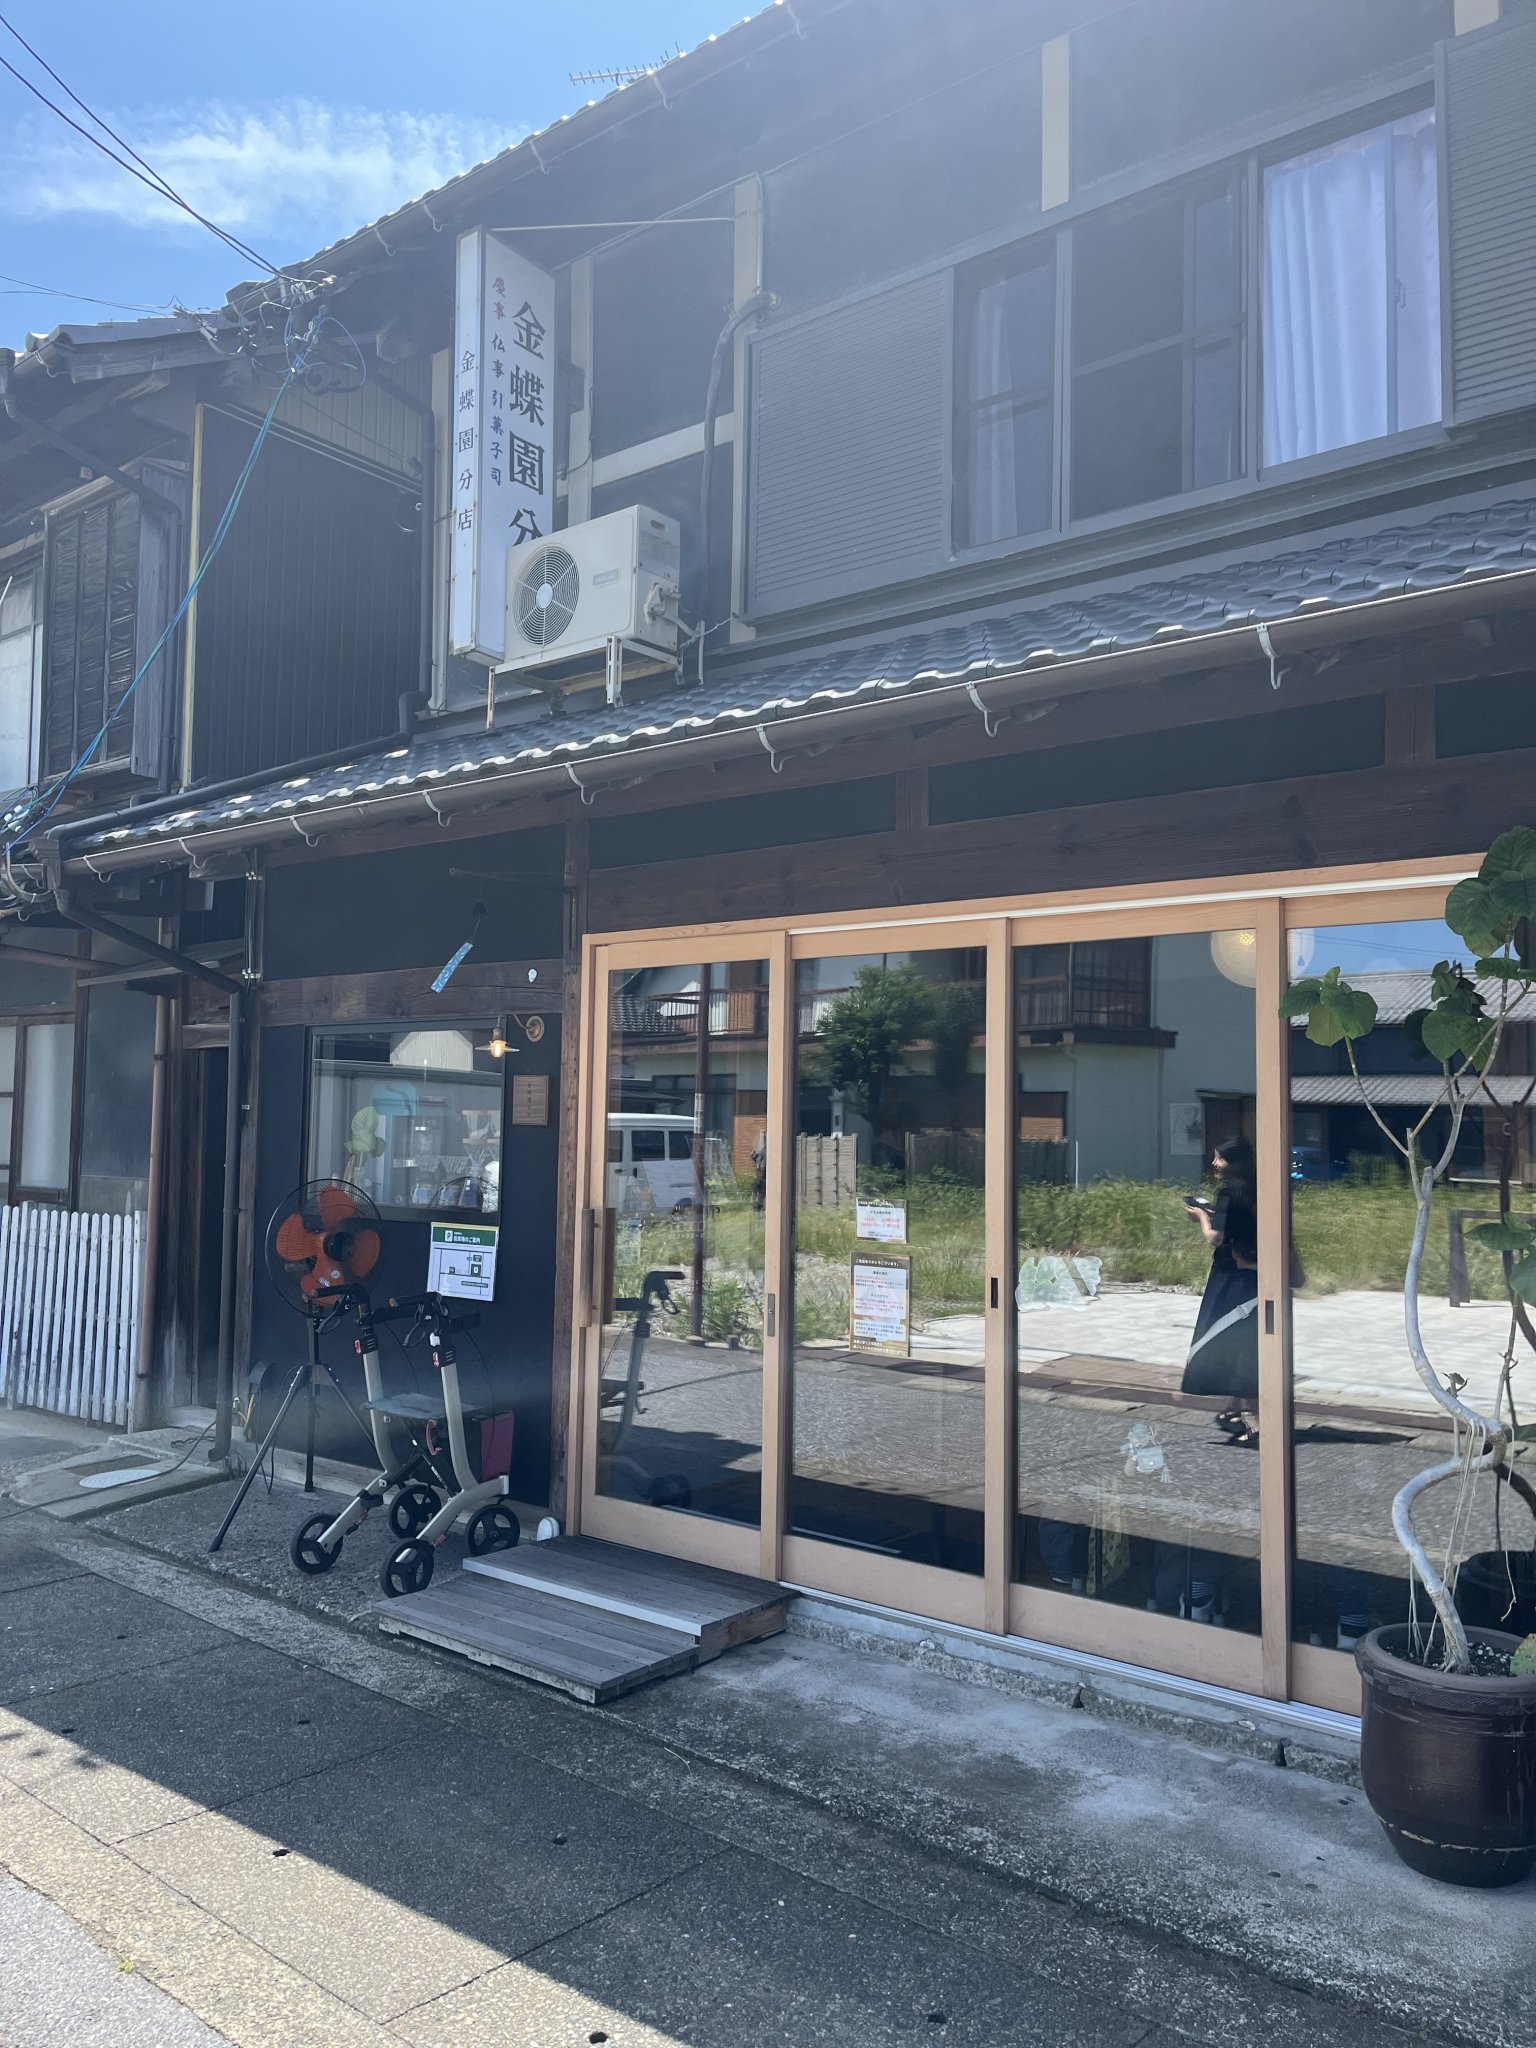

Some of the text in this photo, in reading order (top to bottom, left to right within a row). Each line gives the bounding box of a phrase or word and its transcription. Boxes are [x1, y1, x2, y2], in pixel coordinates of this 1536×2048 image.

[457, 350, 475, 531] 金蝶園分店
